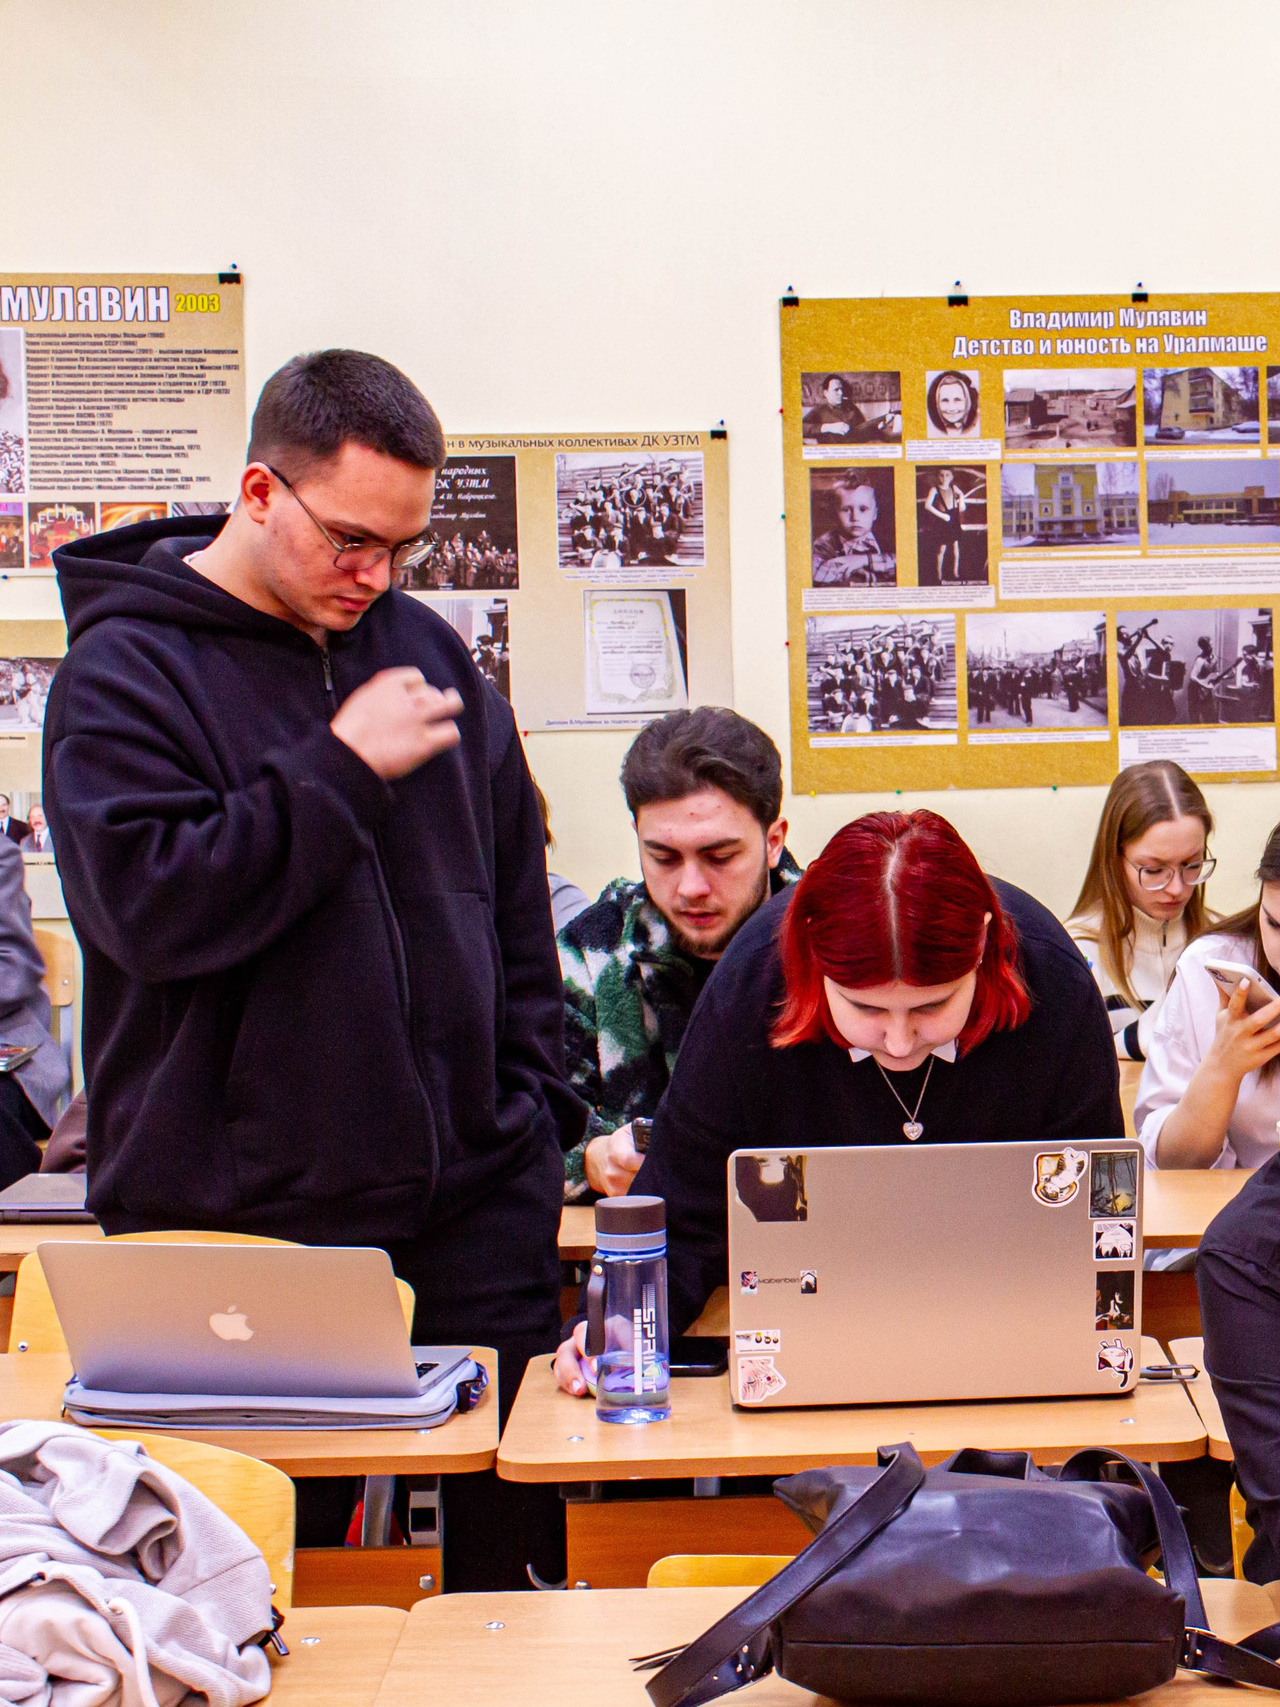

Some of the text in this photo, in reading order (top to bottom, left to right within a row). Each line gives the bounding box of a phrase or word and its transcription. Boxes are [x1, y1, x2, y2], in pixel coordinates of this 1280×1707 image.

[0, 286, 220, 322] МУЛЯВИН 2003
[1009, 307, 1208, 330] Владимир Мулявин
[952, 333, 1268, 359] Детство и юность на Уралмаше
[458, 440, 465, 448] в
[468, 438, 555, 452] музыкальных
[558, 436, 638, 448] коллективах
[641, 435, 660, 448] ДК
[663, 434, 699, 447] УЗТМ
[441, 464, 487, 479] народных
[30, 503, 94, 536] ПЕСНЯРЫ
[642, 1308, 657, 1394] SPRINT
